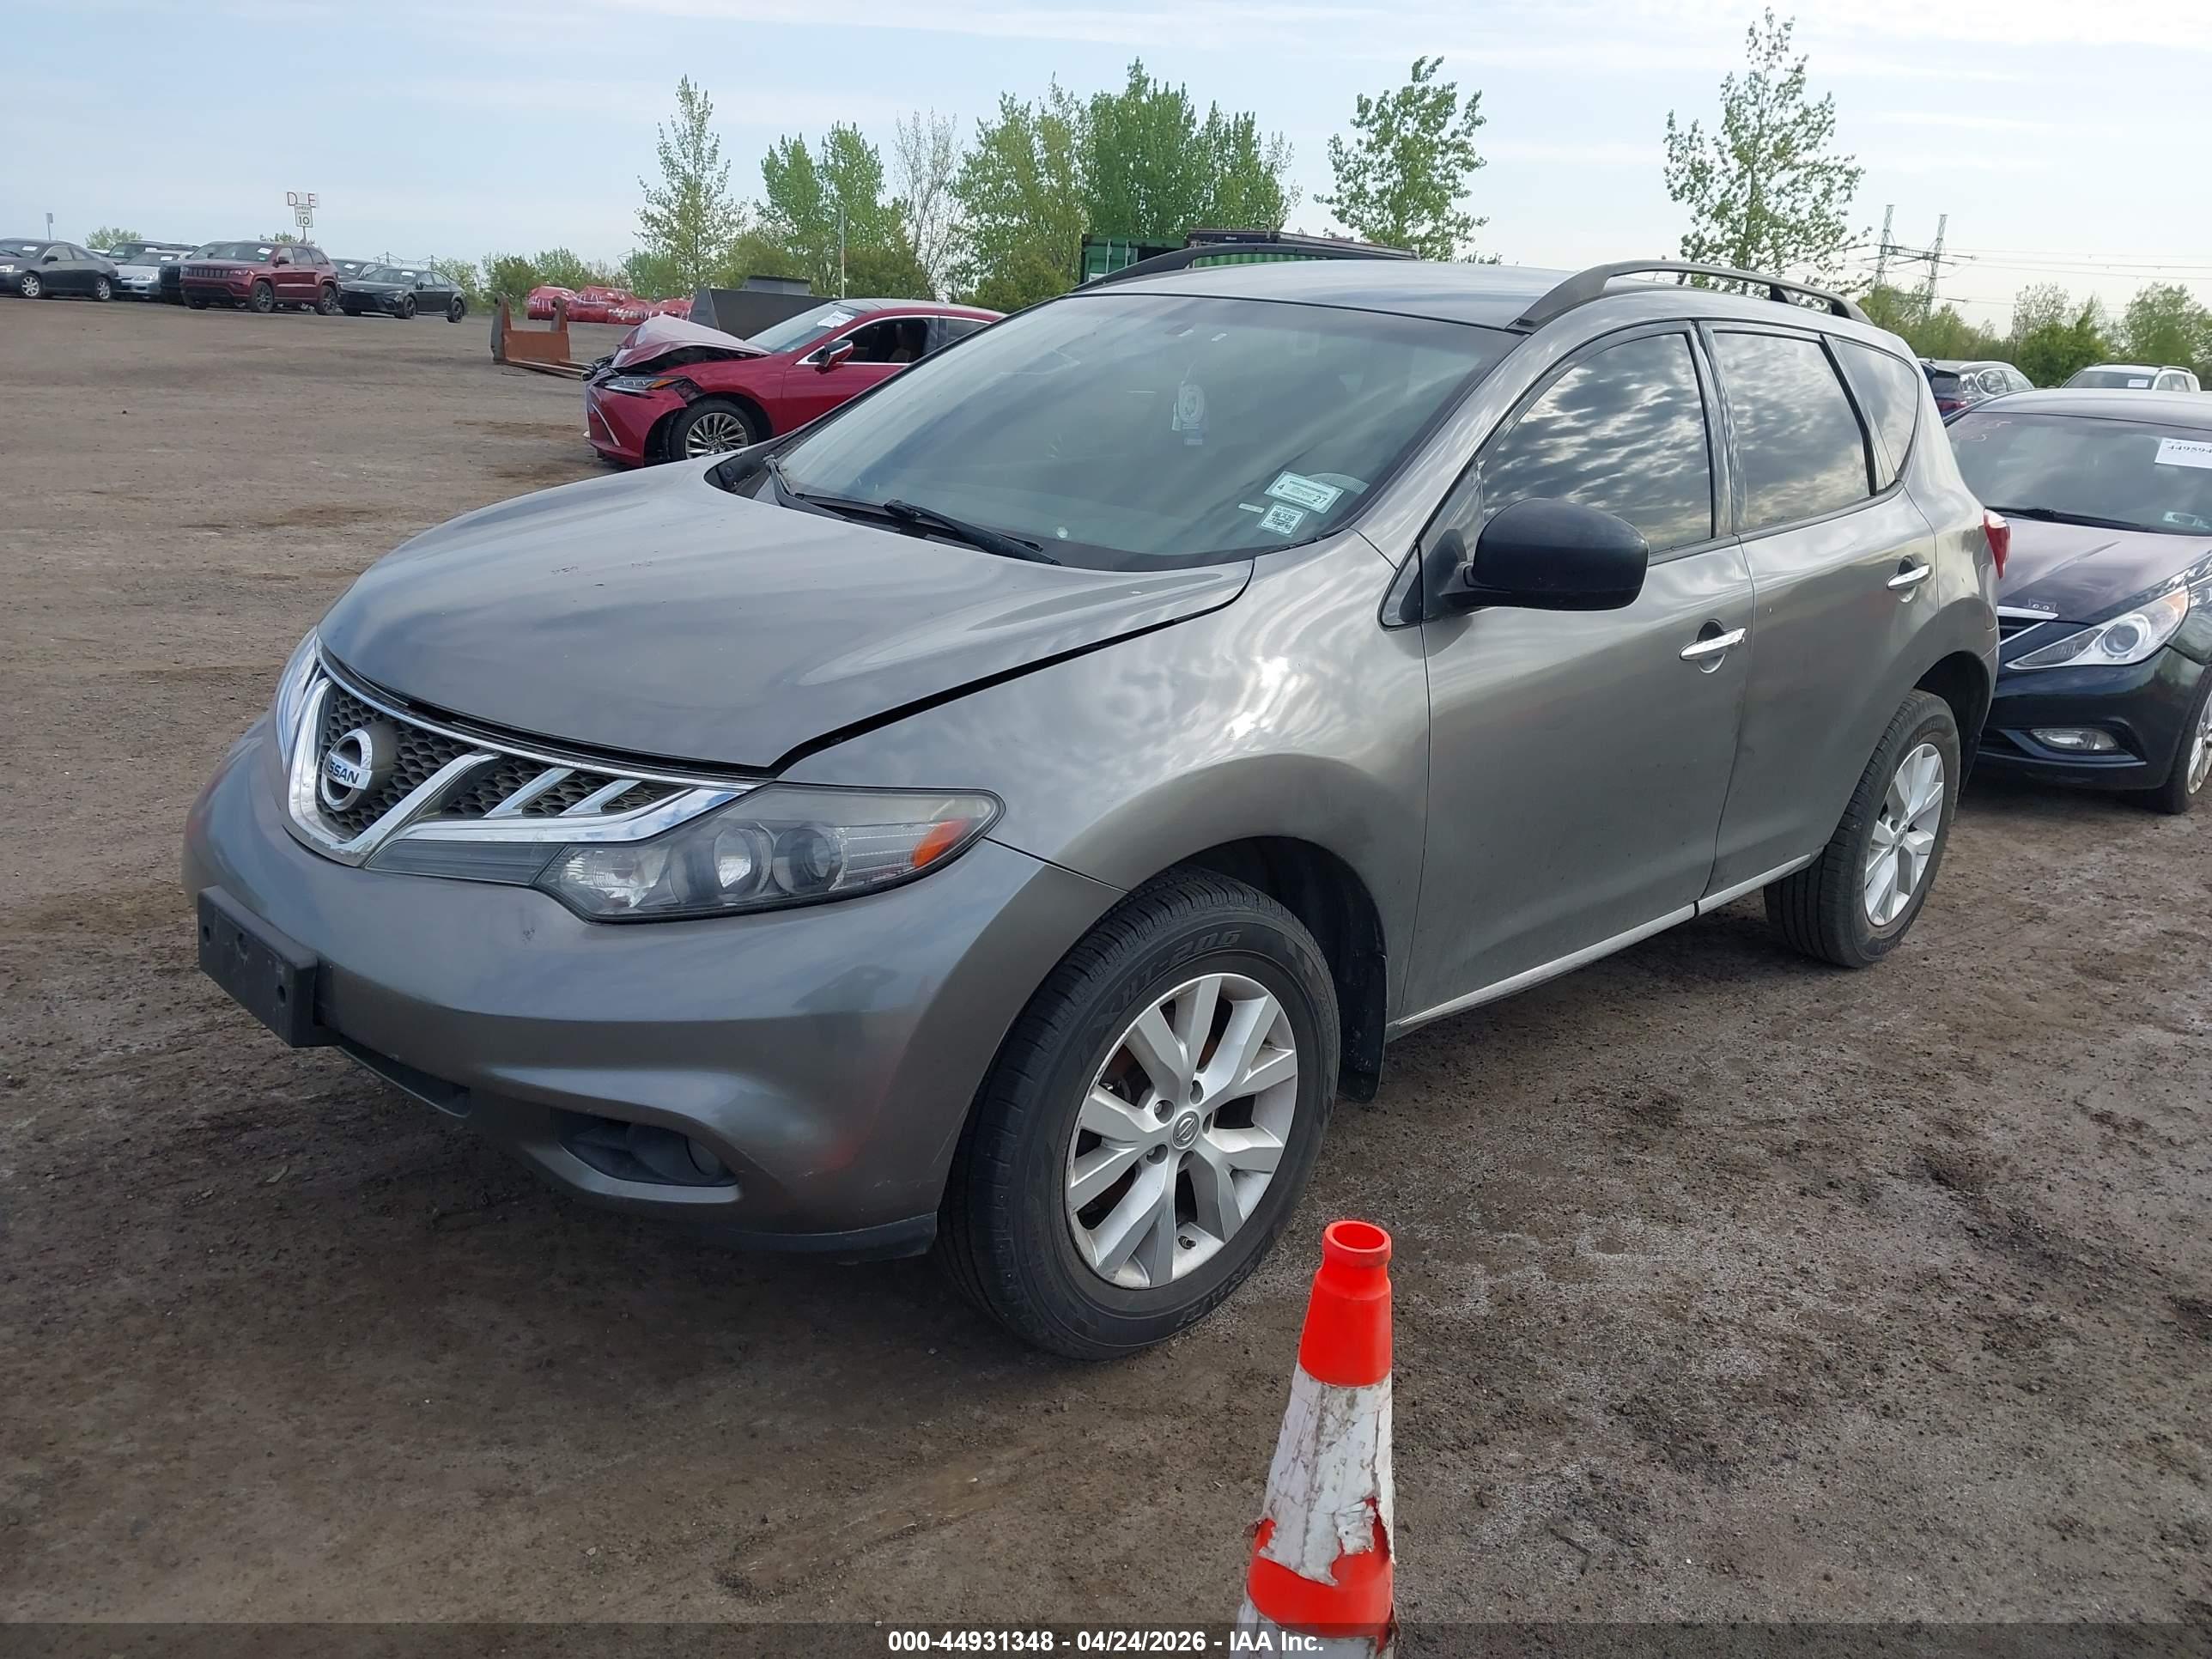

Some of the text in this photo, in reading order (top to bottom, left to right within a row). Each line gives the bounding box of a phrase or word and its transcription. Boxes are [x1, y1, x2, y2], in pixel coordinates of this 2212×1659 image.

[287, 191, 298, 206] D
[298, 216, 310, 226] 10
[1312, 495, 1328, 504] 27
[326, 760, 360, 784] SSAN
